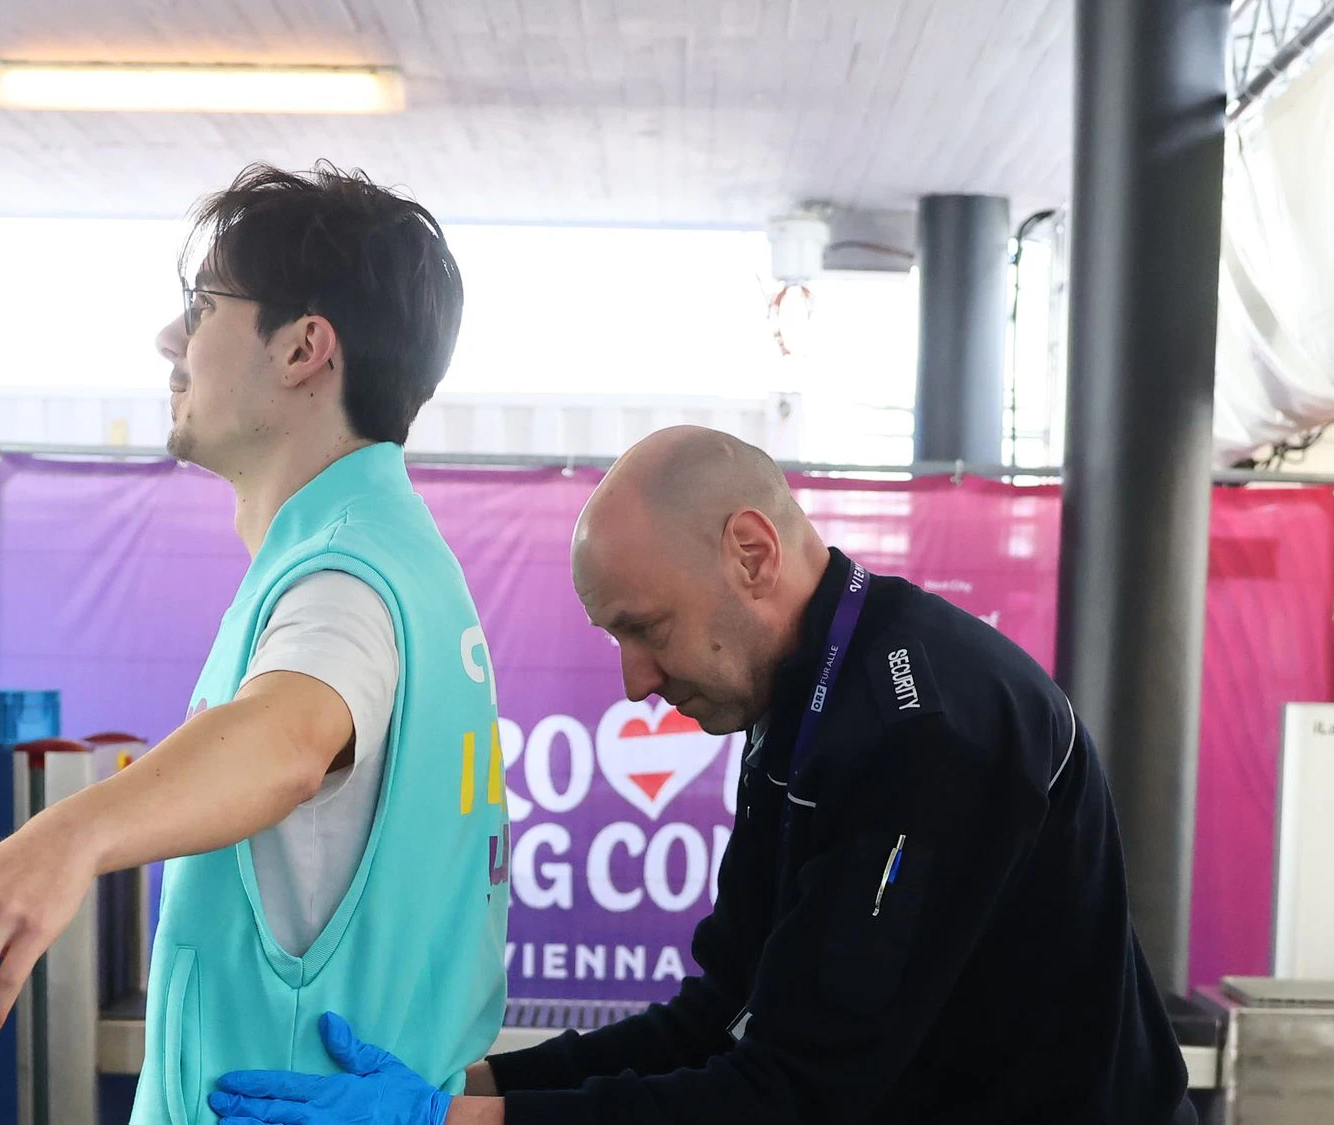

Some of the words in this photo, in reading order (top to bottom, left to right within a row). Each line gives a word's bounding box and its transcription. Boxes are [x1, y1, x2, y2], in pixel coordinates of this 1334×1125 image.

[812, 685, 827, 711] ORF
[827, 645, 839, 667] ALLE
[887, 648, 921, 710] SECURITY
